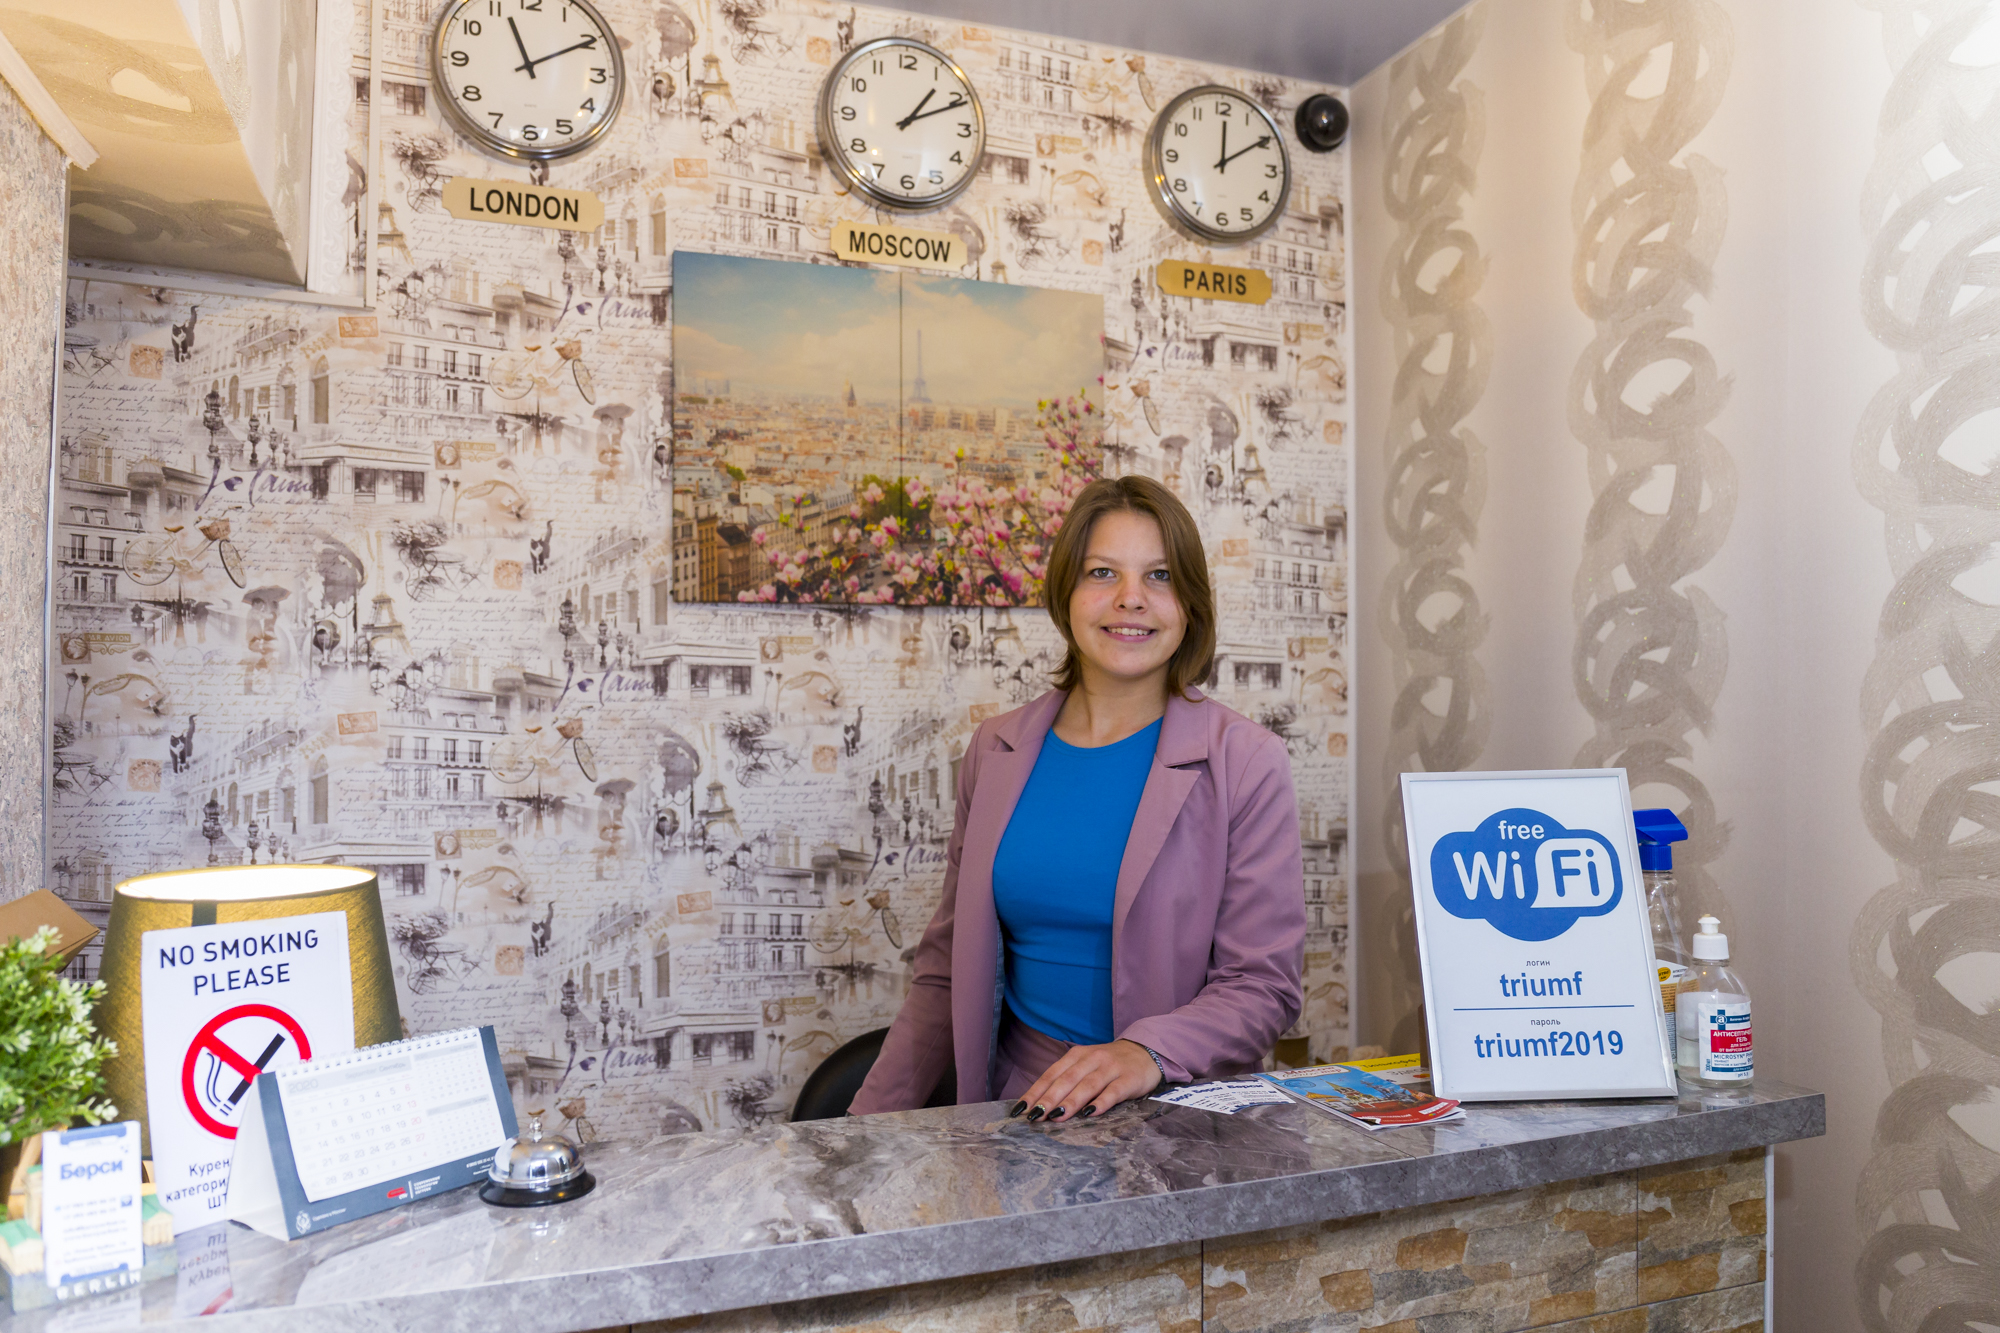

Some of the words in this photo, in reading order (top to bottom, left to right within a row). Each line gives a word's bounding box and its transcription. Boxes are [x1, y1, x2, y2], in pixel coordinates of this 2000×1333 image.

[489, 0, 501, 17] 11
[562, 7, 567, 22] 1
[463, 19, 482, 36] 10
[450, 50, 470, 67] 9
[899, 53, 918, 71] 12
[873, 59, 883, 75] 11
[934, 66, 938, 81] 1
[589, 68, 607, 84] 3
[852, 77, 867, 93] 10
[462, 85, 482, 102] 8
[579, 97, 596, 113] 4
[1215, 101, 1232, 117] 12
[487, 111, 504, 129] 7
[841, 106, 856, 121] 9
[1193, 106, 1202, 121] 11
[1245, 113, 1249, 126] 1
[522, 124, 539, 141] 6
[555, 119, 574, 135] 5
[957, 123, 972, 138] 3
[1174, 122, 1188, 137] 10
[850, 138, 867, 153] 8
[949, 151, 963, 165] 4
[1165, 149, 1179, 163] 9
[872, 163, 885, 179] 7
[929, 170, 944, 185] 5
[1265, 164, 1278, 179] 3
[900, 175, 916, 190] 6
[1174, 178, 1187, 192] 8
[470, 187, 578, 222] LONDON
[1258, 190, 1270, 203] 4
[1192, 200, 1203, 216] 7
[1240, 208, 1254, 222] 5
[1216, 212, 1229, 226] 6
[850, 230, 950, 262] MOSCOW
[1184, 269, 1247, 295] PARIS
[1498, 820, 1545, 840] free
[160, 945, 194, 969] NO
[203, 929, 319, 962] SMOKING
[194, 963, 291, 996] PLEASE
[1500, 971, 1583, 997] triumf
[1531, 1018, 1561, 1027] пароль
[1474, 1030, 1624, 1059] triumf2019
[288, 1078, 319, 1093] 2020
[361, 1111, 372, 1119] 10
